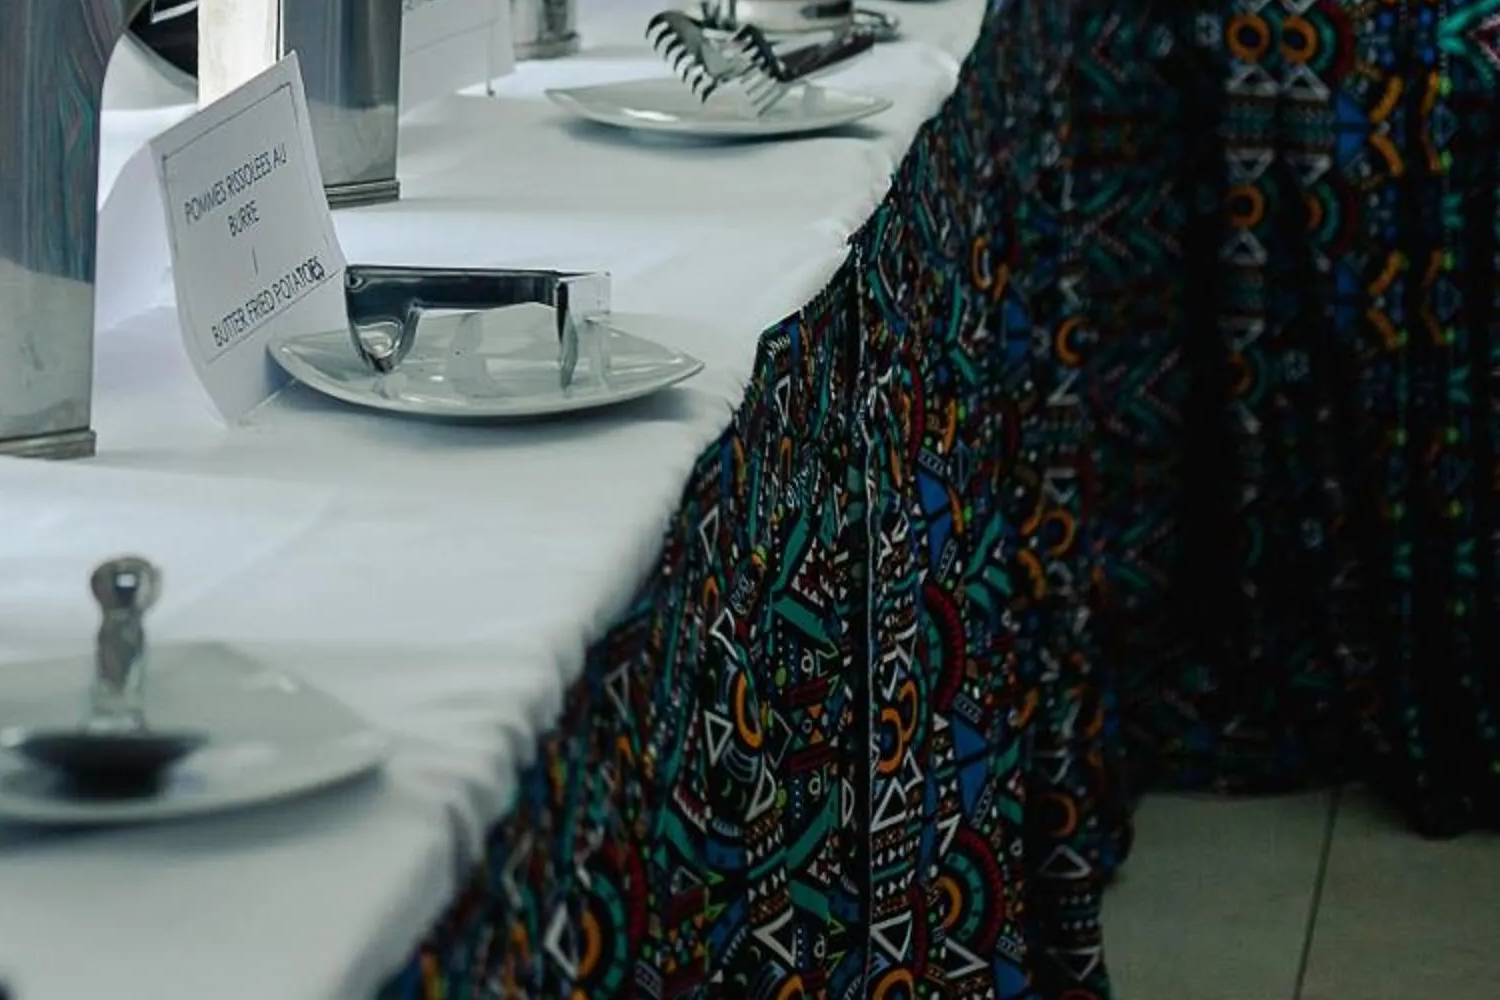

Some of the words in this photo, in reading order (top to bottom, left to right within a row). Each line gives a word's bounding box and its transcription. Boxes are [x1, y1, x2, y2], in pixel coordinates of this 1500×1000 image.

[184, 180, 227, 225] POMMES
[273, 142, 287, 169] AU
[211, 307, 250, 347] BUTTER
[245, 289, 275, 324] FRIED
[271, 256, 325, 303] POTATOES
